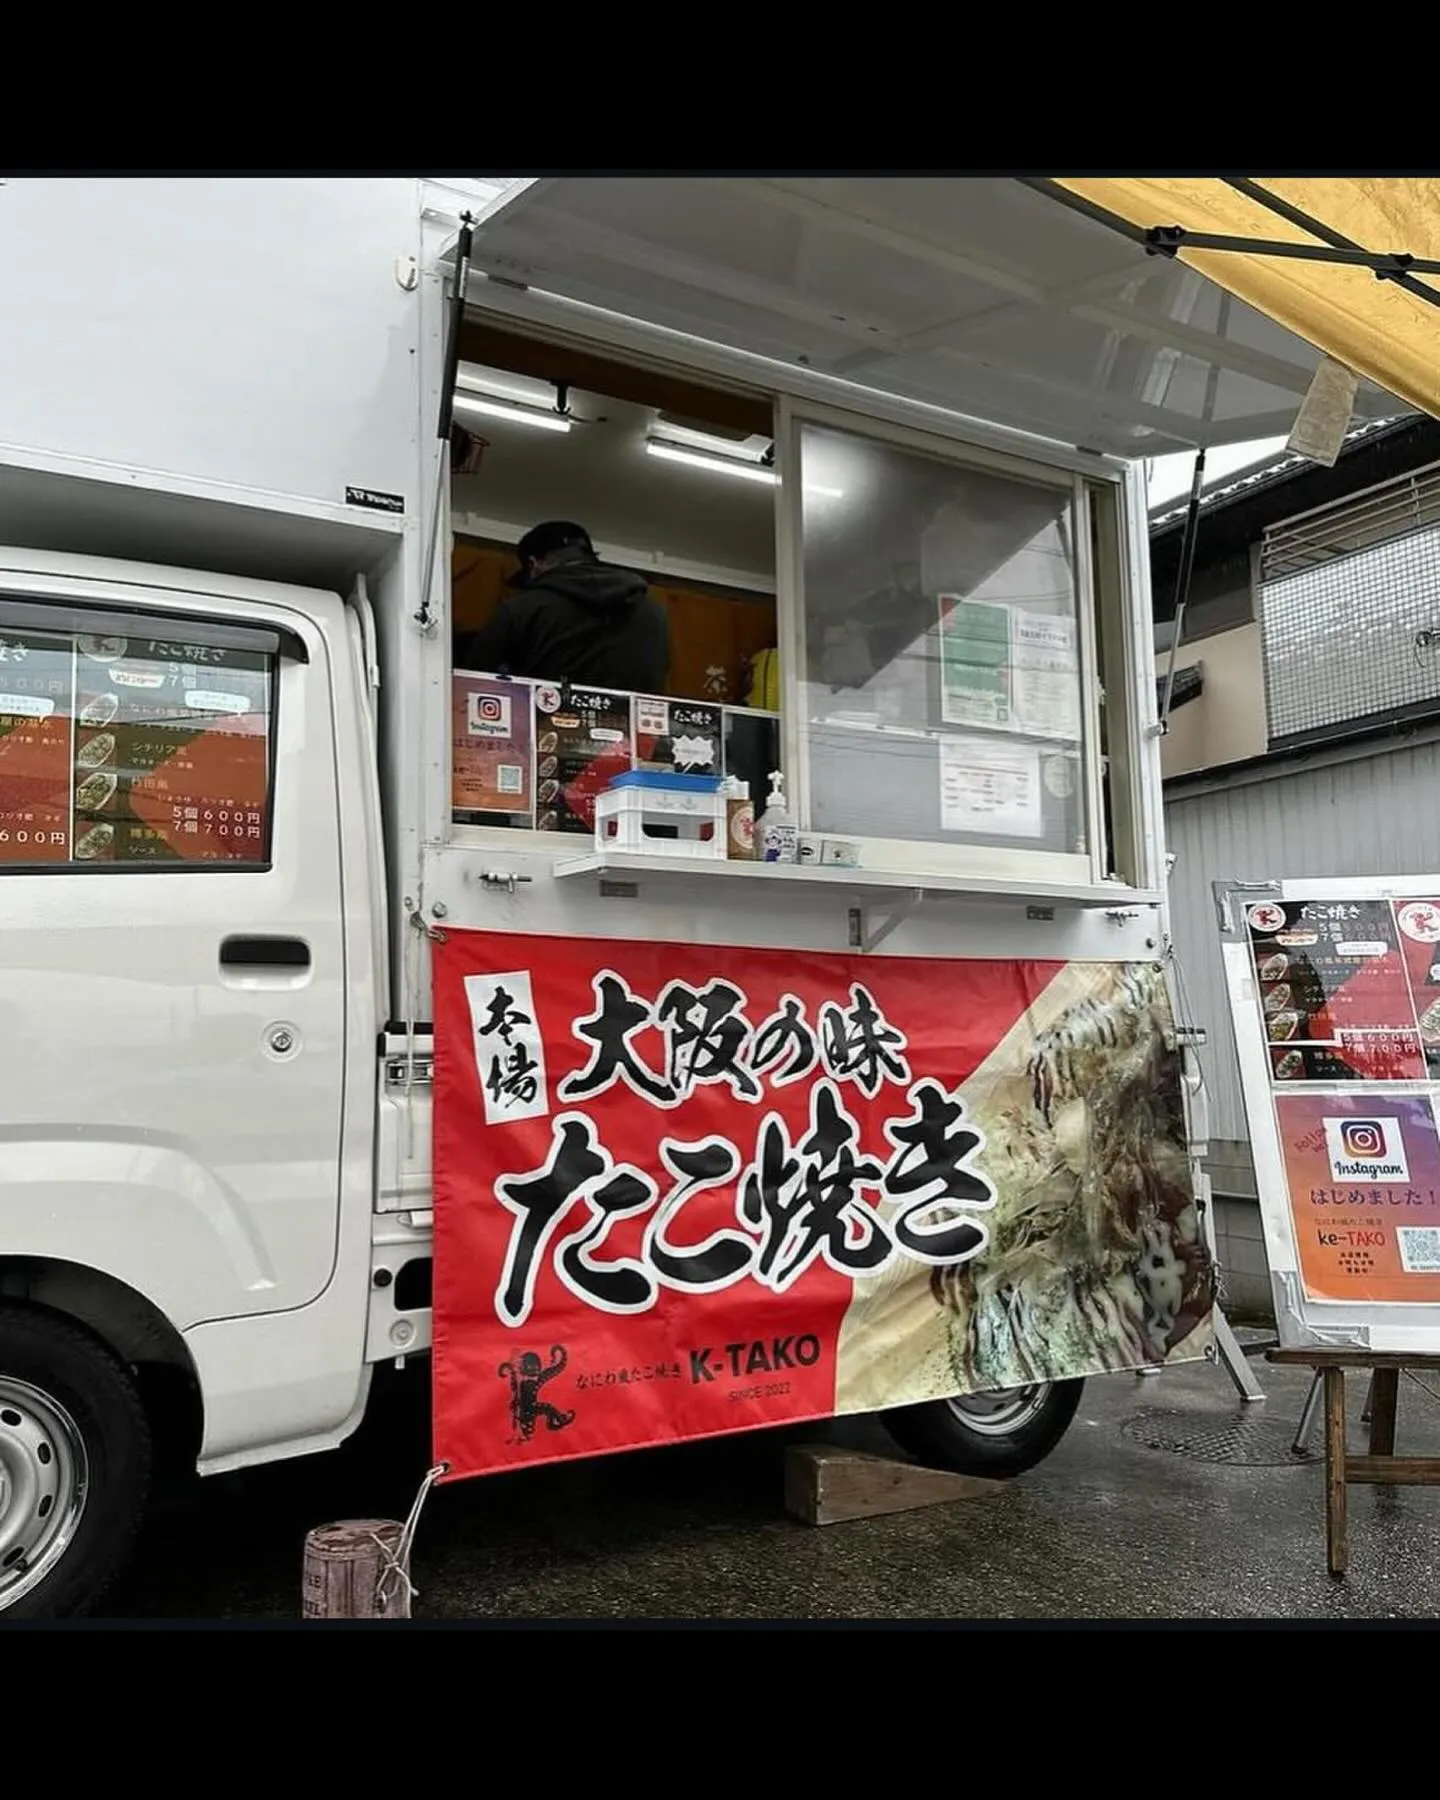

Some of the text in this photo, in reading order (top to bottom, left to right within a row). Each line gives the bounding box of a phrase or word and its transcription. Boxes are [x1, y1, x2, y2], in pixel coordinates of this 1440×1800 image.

[172, 806, 260, 824] 5個600円
[172, 821, 260, 839] 7個700円
[1301, 904, 1360, 920] たこ焼き
[478, 985, 540, 1108] 本場
[559, 970, 911, 1106] 大阪の味
[1334, 1161, 1403, 1179] Instagram
[494, 1080, 996, 1325] たこ焼き
[1311, 1189, 1436, 1206] はじめました！
[1318, 1229, 1386, 1247] ke-TAKO
[689, 1334, 821, 1384] K-TAKO
[728, 1382, 791, 1401] SINCE 2022
